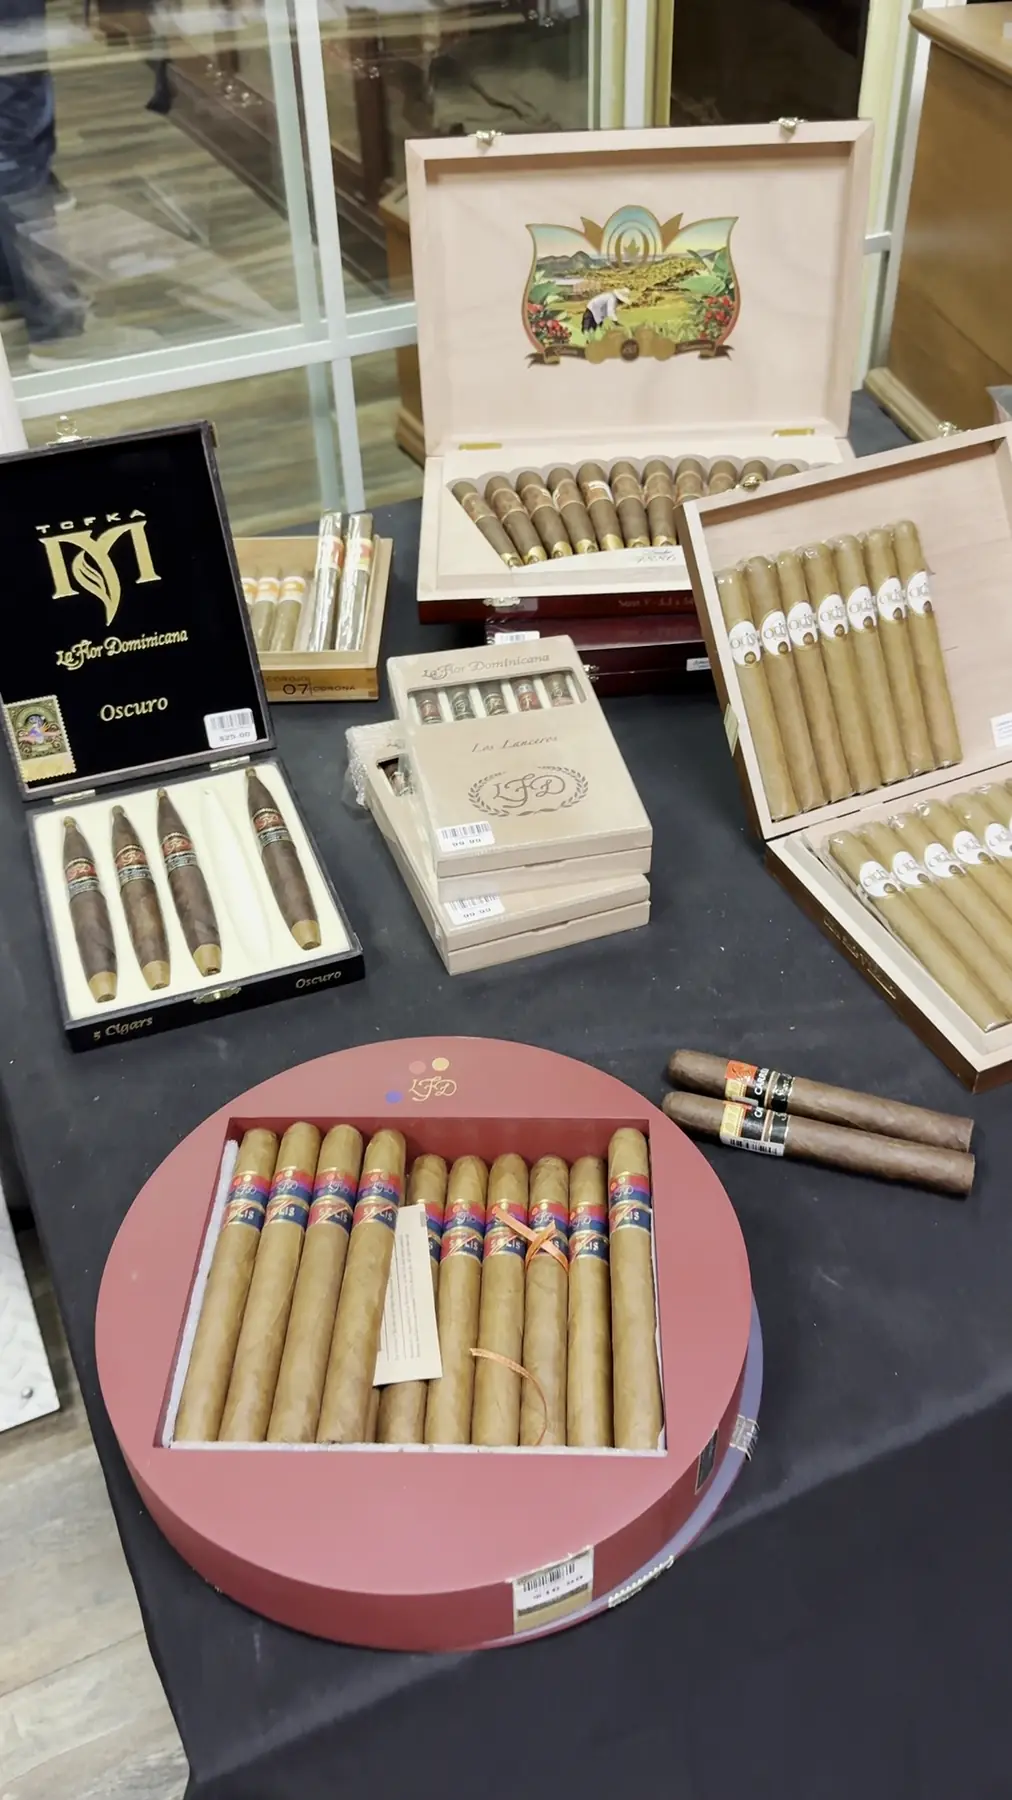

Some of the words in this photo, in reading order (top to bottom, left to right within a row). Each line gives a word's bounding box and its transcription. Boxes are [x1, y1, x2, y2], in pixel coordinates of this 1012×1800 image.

[67, 639, 104, 671] Flor
[104, 629, 189, 657] Dominicana
[468, 653, 551, 672] Dominicana
[100, 697, 169, 722] Oscuro
[295, 970, 343, 990] Oscuro
[105, 1016, 154, 1037] Cigars
[408, 1075, 457, 1102] LFD
